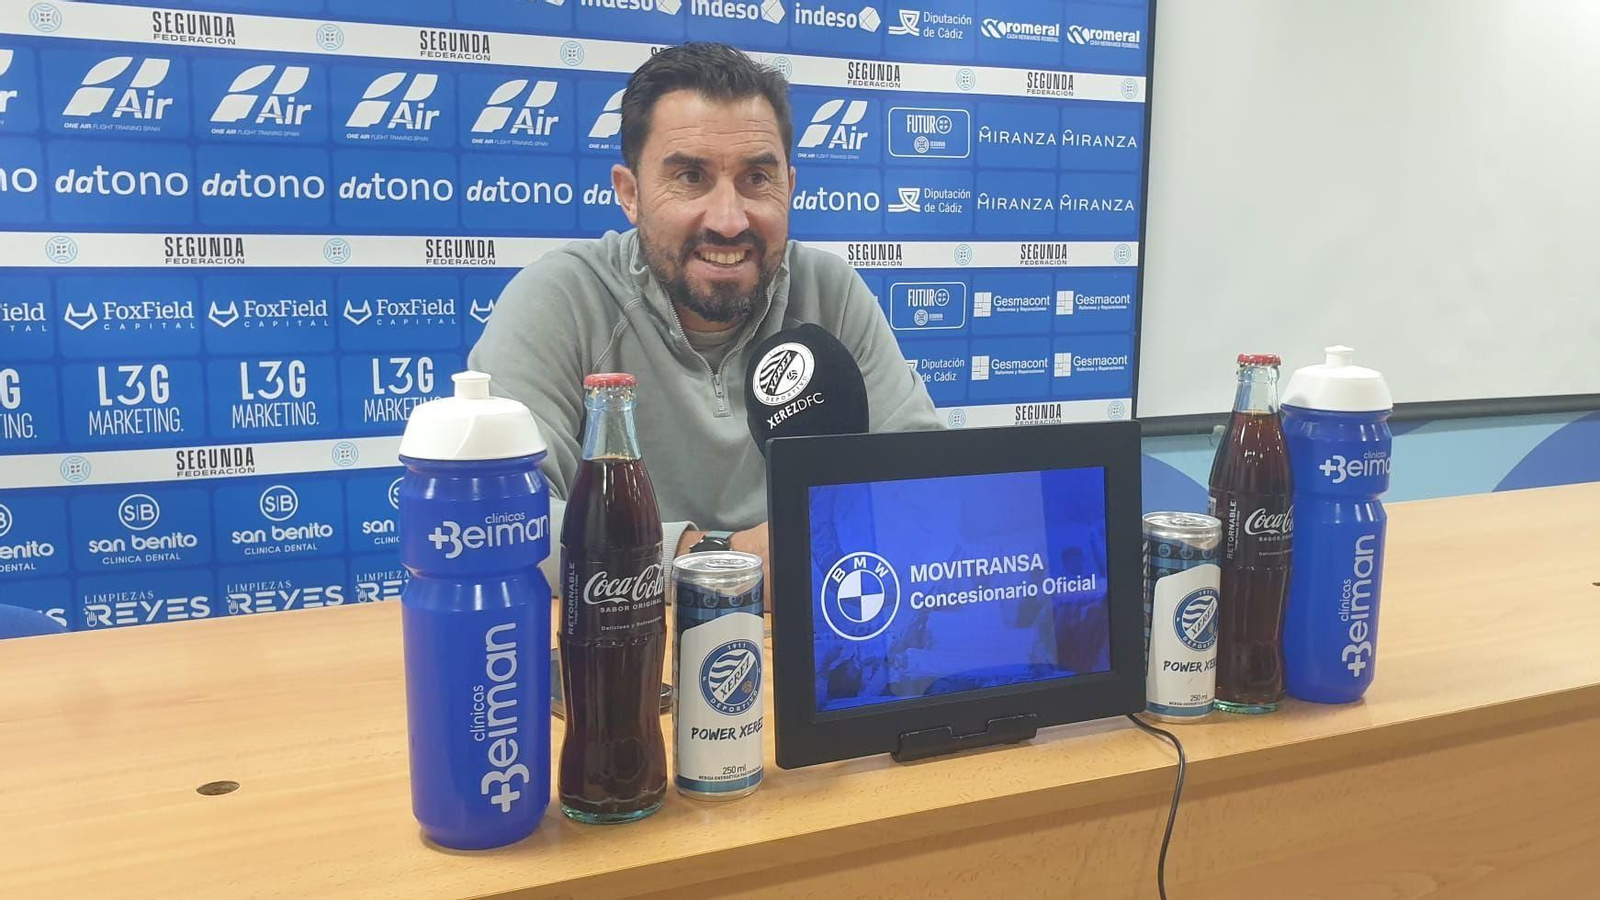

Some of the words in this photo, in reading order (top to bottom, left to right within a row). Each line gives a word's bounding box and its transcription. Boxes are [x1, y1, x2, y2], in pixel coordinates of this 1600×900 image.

[691, 0, 758, 20] indeso
[795, 3, 857, 29] indeso
[923, 12, 972, 26] Diputación
[152, 10, 236, 38] SEGUNDA
[923, 27, 934, 38] de
[938, 26, 963, 39] Cádiz
[1006, 22, 1060, 36] romeral
[153, 34, 236, 46] FEDERACIÓN
[420, 30, 490, 54] SEGUNDA
[1090, 28, 1140, 42] romeral
[420, 51, 491, 61] FEDERACIÓN
[848, 62, 900, 82] SEGUNDA
[1027, 72, 1074, 91] SEGUNDA
[847, 80, 901, 88] FEDERACIÓN
[112, 88, 173, 120] Air
[255, 95, 312, 125] Air
[388, 102, 440, 130] Air
[510, 108, 559, 135] Air
[828, 124, 868, 150] Air
[979, 126, 1056, 145] MIRANZA
[1062, 129, 1137, 148] MIRANZA
[54, 165, 188, 196] datono
[202, 169, 324, 198] datono
[339, 173, 453, 201] datono
[467, 176, 573, 204] datono
[793, 187, 880, 211] datono
[924, 188, 971, 200] Diputación
[977, 193, 1054, 210] MIRANZA
[1060, 194, 1134, 211] MIRANZA
[924, 203, 936, 213] de
[938, 202, 963, 213] Cádiz
[165, 236, 244, 257] SEGUNDA
[426, 239, 495, 258] SEGUNDA
[848, 244, 902, 260] SEGUNDA
[1020, 244, 1067, 259] SEGUNDA
[244, 300, 328, 317] FoxField
[377, 299, 455, 316] FoxField
[993, 295, 1050, 307] Gesmacont
[1075, 294, 1130, 305] Gesmacont
[103, 302, 194, 319] FoxField
[921, 358, 965, 370] Diputación
[991, 358, 1048, 370] Gesmacont
[1073, 355, 1127, 367] Gesmacont
[98, 364, 169, 406] L3G
[240, 360, 307, 400] L3G
[372, 356, 434, 395] L3G
[934, 371, 956, 382] Cádiz
[232, 402, 319, 428] MARKETING.
[767, 392, 824, 430] XEREZDFC
[1016, 404, 1061, 420] SEGUNDA
[89, 407, 184, 436] MARKETING.
[176, 447, 254, 471] SEGUNDA
[177, 466, 255, 477] FEDERACIÓN
[232, 528, 266, 544] san
[272, 522, 334, 541] benito
[362, 519, 394, 534] san
[1227, 501, 1237, 559] RETORNABLE
[89, 536, 125, 554] san
[132, 532, 198, 550] benito
[374, 536, 400, 544] CLINIC
[443, 514, 548, 559] Beiman
[0, 541, 54, 560] enito
[244, 546, 281, 555] CLINICA
[284, 543, 317, 553] DENTAL
[102, 555, 142, 565] CLINICA
[146, 553, 181, 562] DENTAL
[910, 553, 1044, 583] MOVITRANSA
[357, 570, 410, 582] LIMPIEZA
[831, 556, 888, 583] BMW
[227, 580, 292, 593] LIMPIEZAS
[910, 581, 1038, 610] Concesionario
[1042, 573, 1096, 595] Oficial
[85, 590, 154, 604] LIMPIEZAS
[228, 585, 344, 614] REYES
[1342, 534, 1375, 662] Beiman
[86, 596, 210, 626] REYES
[1164, 660, 1202, 672] POWER
[481, 622, 530, 795] Beiman
[691, 727, 736, 740] POWER
[739, 716, 763, 738] XERE
[722, 766, 736, 775] 250
